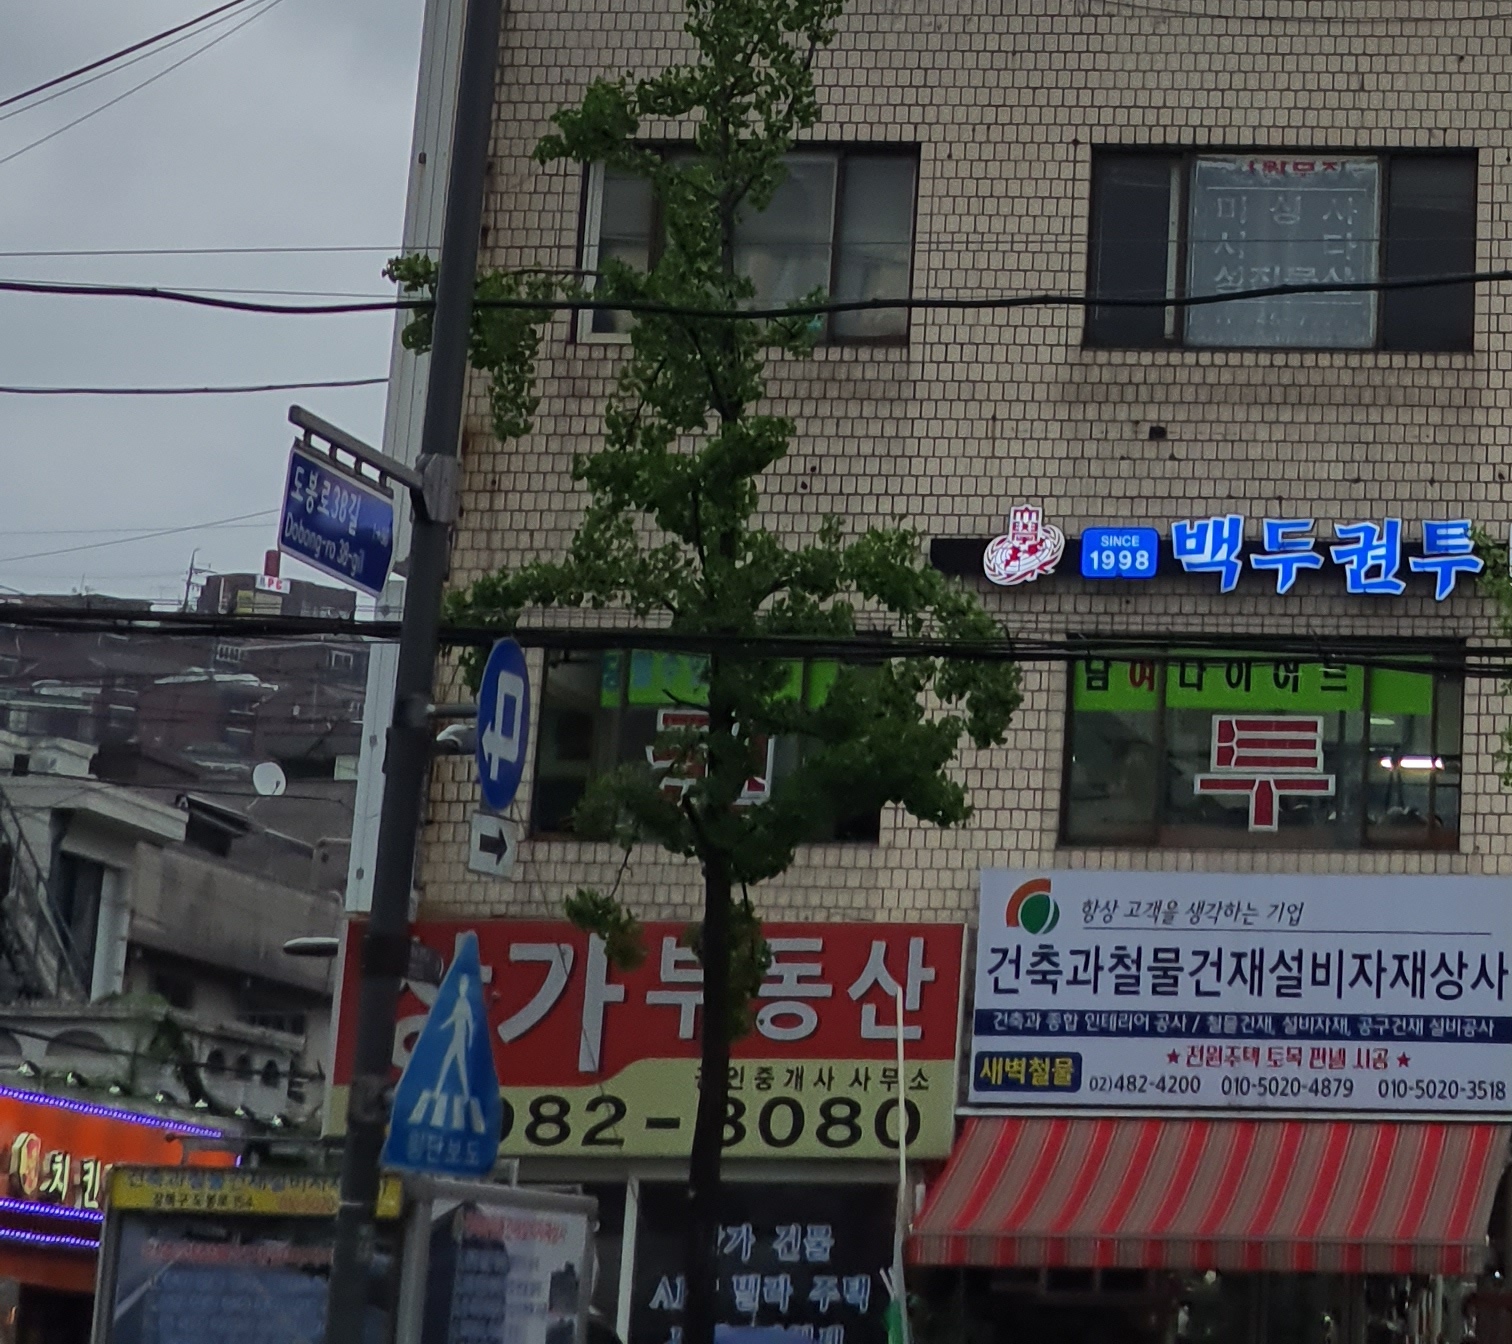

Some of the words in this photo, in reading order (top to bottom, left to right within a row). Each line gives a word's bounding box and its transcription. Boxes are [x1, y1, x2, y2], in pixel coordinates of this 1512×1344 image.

[290, 465, 361, 537] 도봉로38길
[1100, 535, 1140, 547] SINCE
[1090, 550, 1149, 571] 1998
[1172, 514, 1483, 601] 백두권투
[1082, 899, 1119, 925] 항상
[1123, 900, 1179, 925] 고객을
[1186, 900, 1260, 926] 생각하는
[1266, 902, 1305, 926] 기업
[1084, 1014, 1150, 1032] 인테리어
[1154, 1015, 1187, 1033] 공사
[694, 1066, 835, 1092] 인중개사
[848, 1066, 930, 1092] 사무소
[979, 1057, 1075, 1087] 새벽철물
[1089, 1074, 1201, 1094] 02)482-4200
[1221, 1076, 1354, 1098] 010-5020-4879
[1378, 1079, 1506, 1100] 010-5020-3518
[497, 1094, 922, 1150] 82-8080
